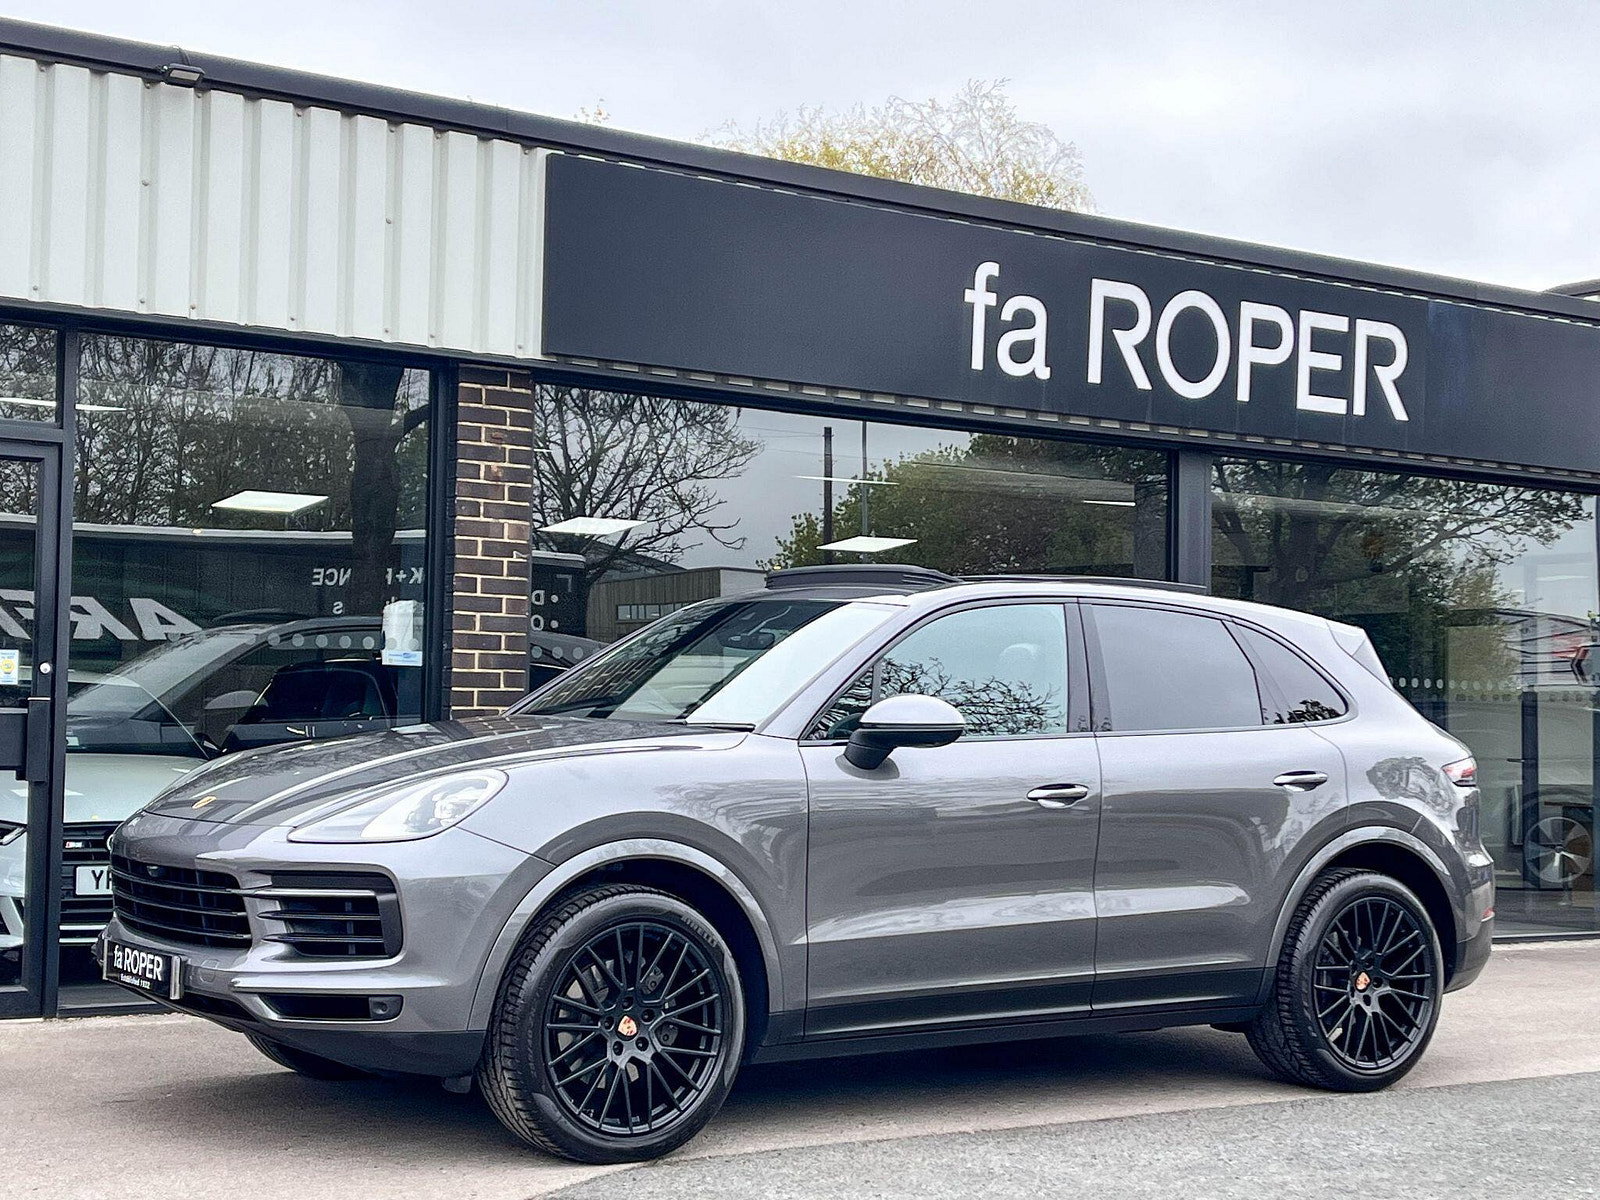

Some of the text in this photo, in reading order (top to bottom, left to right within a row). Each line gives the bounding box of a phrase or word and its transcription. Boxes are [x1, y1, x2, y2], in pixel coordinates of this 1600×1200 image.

[964, 261, 1409, 422] fa ROPER
[113, 944, 163, 981] fa ROPER
